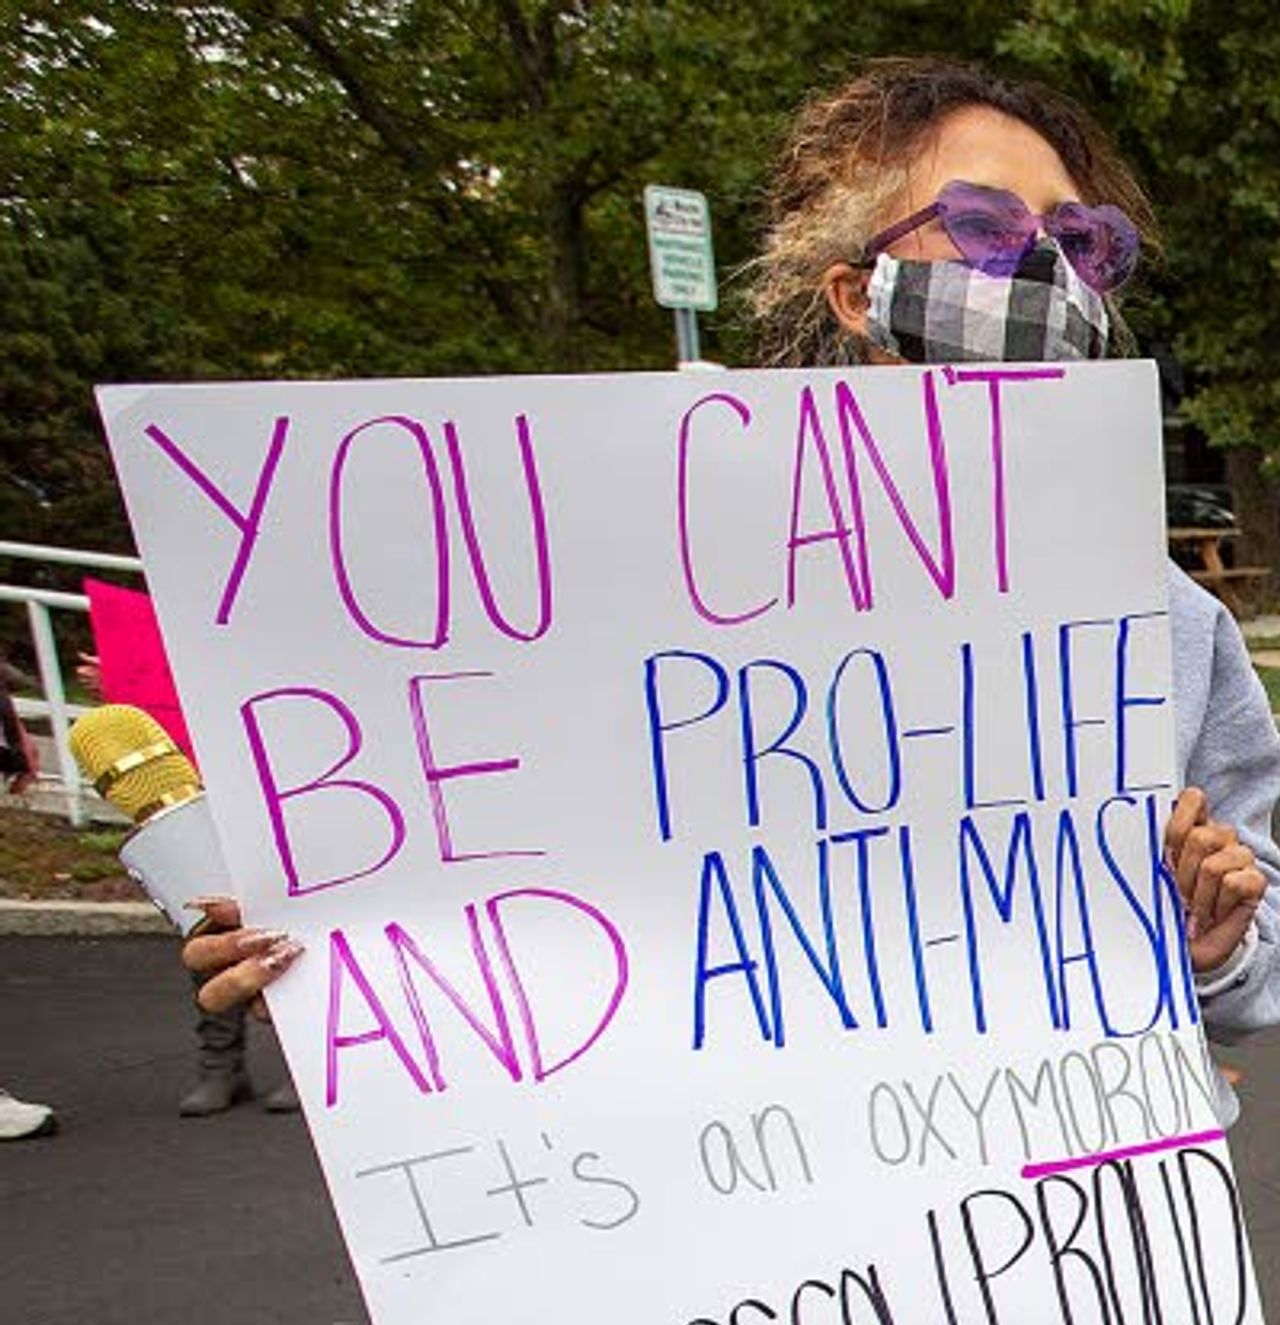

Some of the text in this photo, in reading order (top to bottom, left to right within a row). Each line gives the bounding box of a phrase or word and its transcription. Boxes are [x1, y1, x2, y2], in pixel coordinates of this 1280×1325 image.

[144, 364, 1066, 650] YOU CAN'T
[240, 610, 1172, 898] BE PRO-LIFE
[326, 795, 1200, 1108] AND ANTI-MASK
[354, 1026, 1222, 1265] It's an OXYMORON
